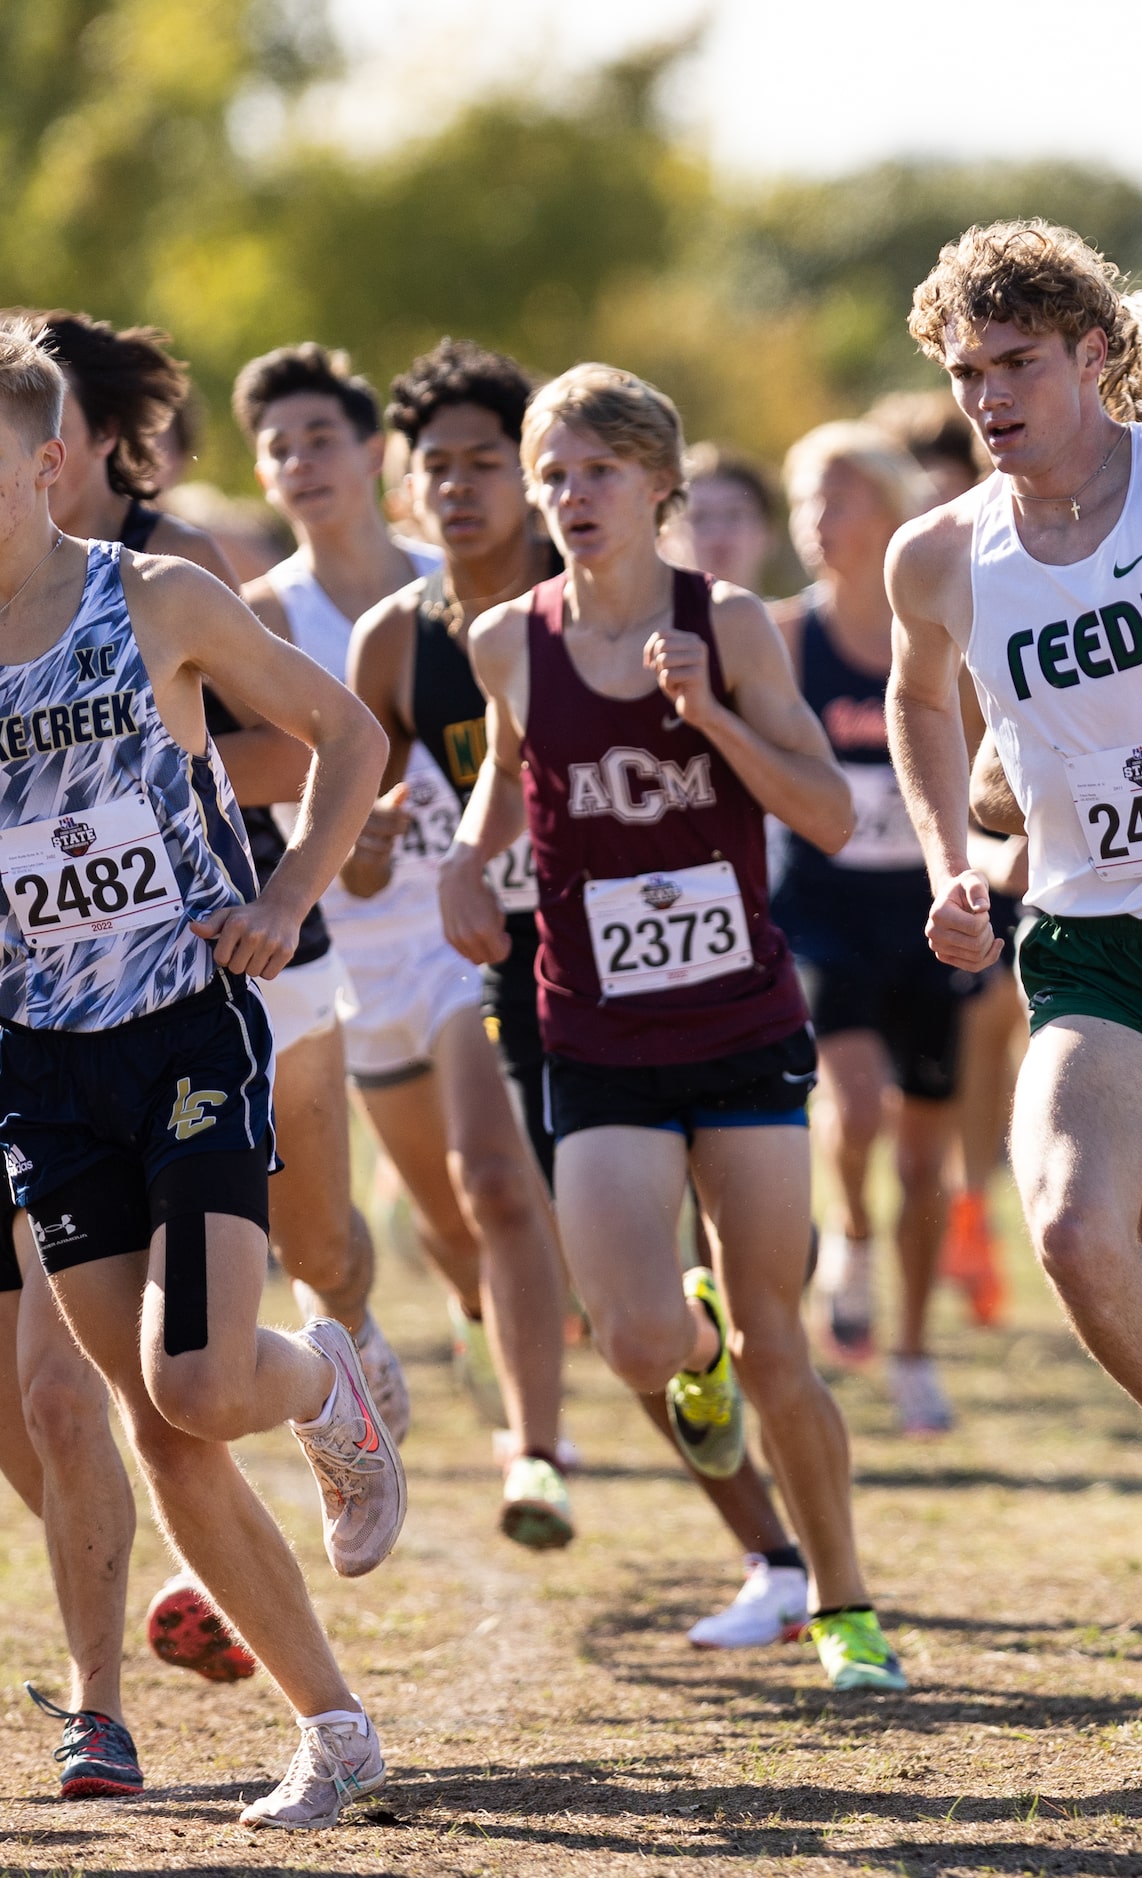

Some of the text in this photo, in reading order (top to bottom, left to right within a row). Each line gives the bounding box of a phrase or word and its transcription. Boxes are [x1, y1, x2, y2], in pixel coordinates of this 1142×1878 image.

[74, 644, 116, 683] XC
[32, 690, 138, 754] CREEK
[52, 828, 97, 848] STATE
[14, 846, 168, 928] 2482
[91, 921, 113, 932] 2022
[603, 905, 736, 972] 2373
